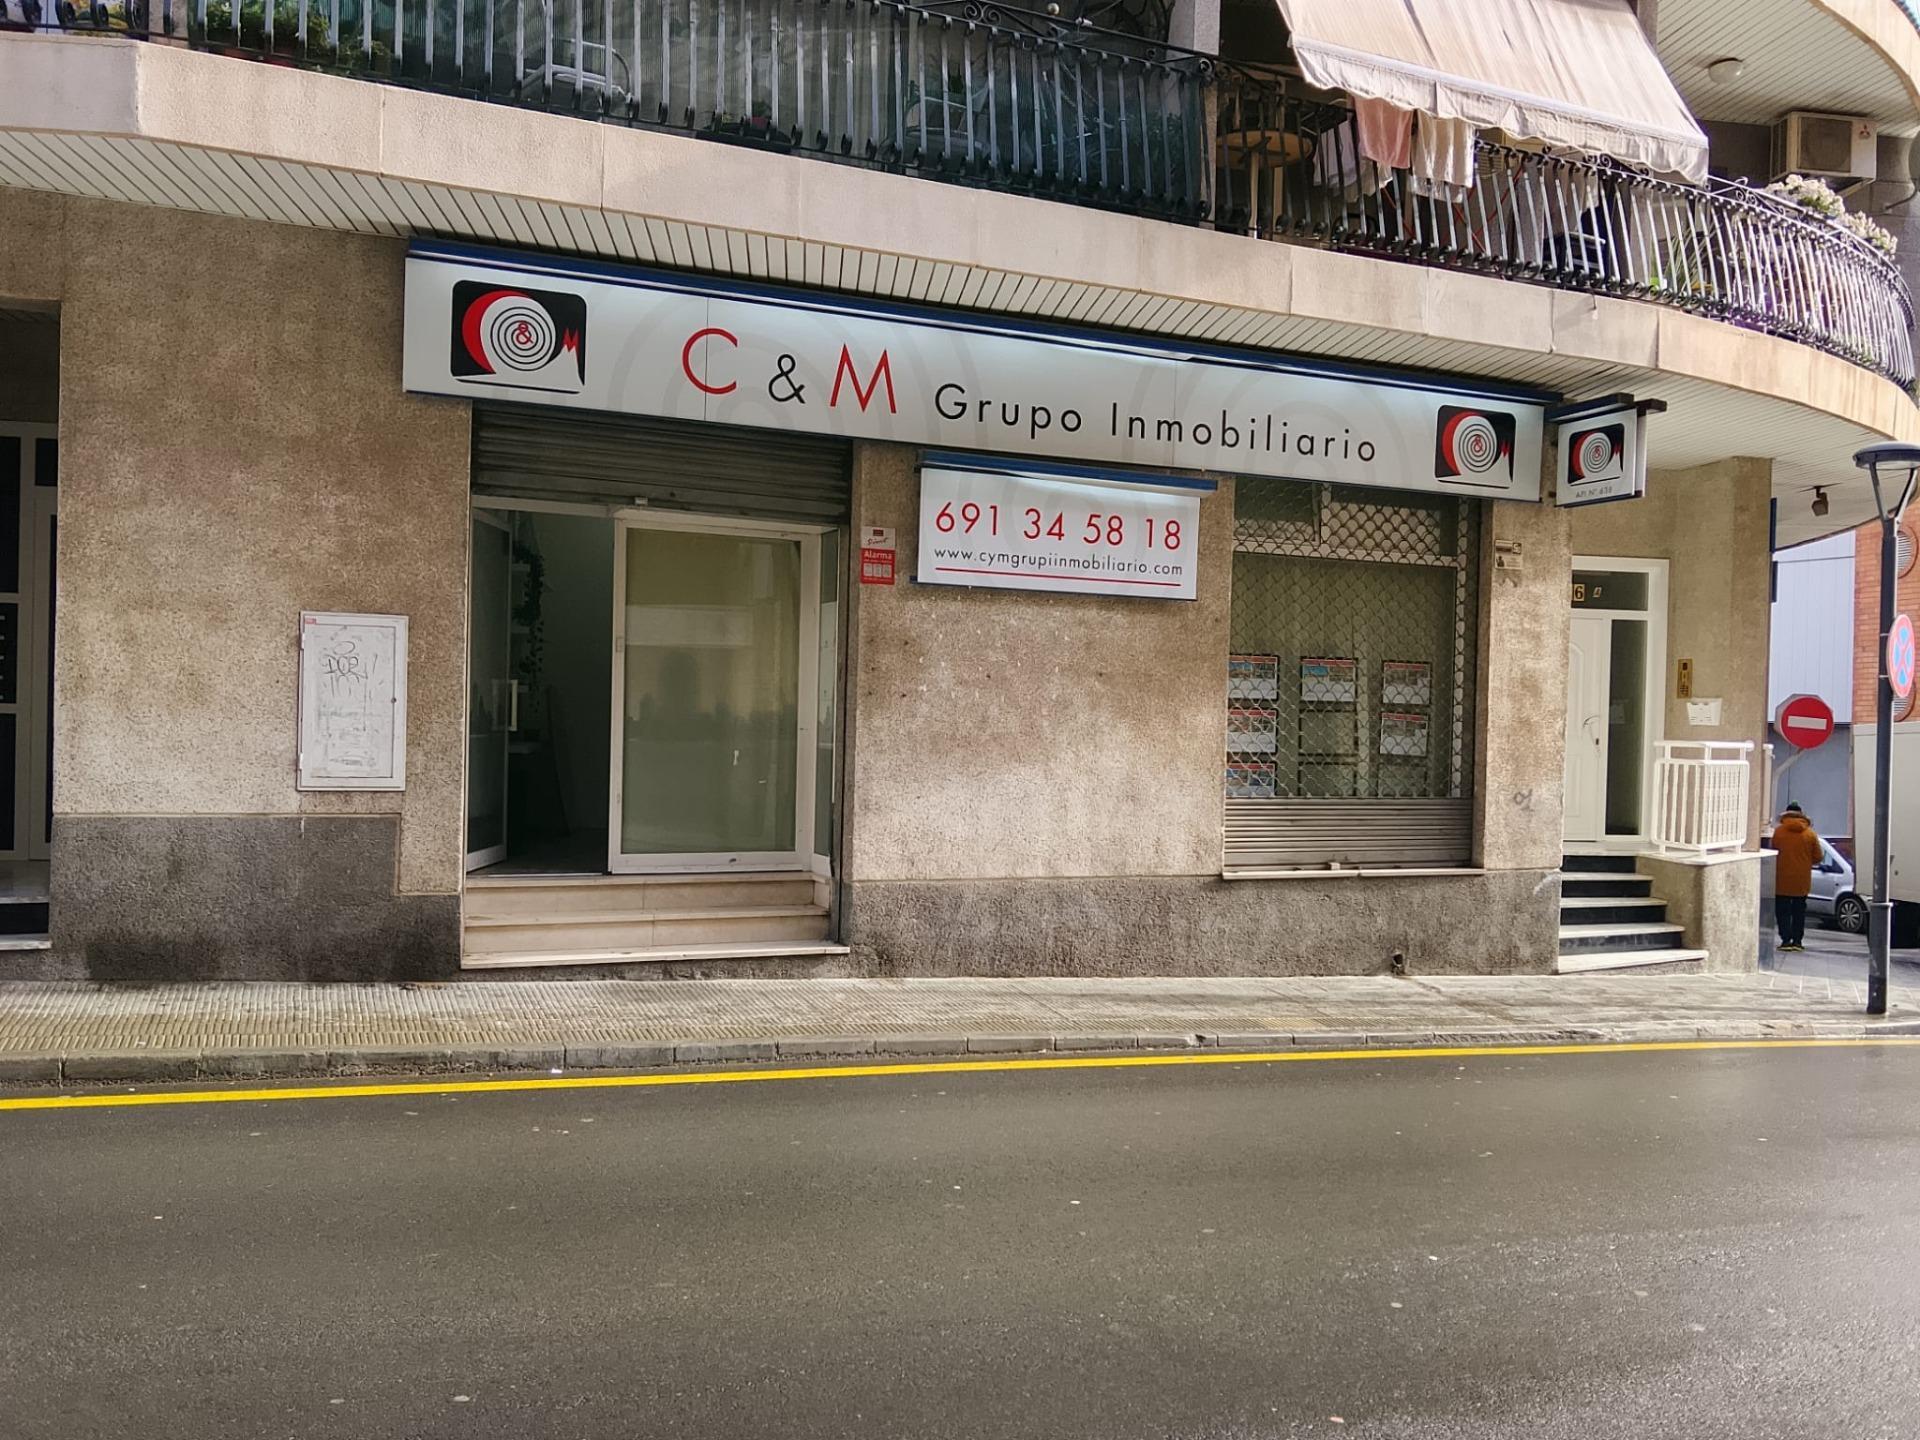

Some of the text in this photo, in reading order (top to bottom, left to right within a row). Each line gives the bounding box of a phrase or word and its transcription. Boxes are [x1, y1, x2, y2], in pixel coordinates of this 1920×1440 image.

[682, 327, 1376, 462] C & M Grupo Inmobiliario
[935, 502, 1181, 550] 691 34 58 18
[863, 549, 893, 560] Alarma
[934, 548, 1183, 577] www.cymgrupiinmobiliario.com
[1574, 585, 1584, 599] 6
